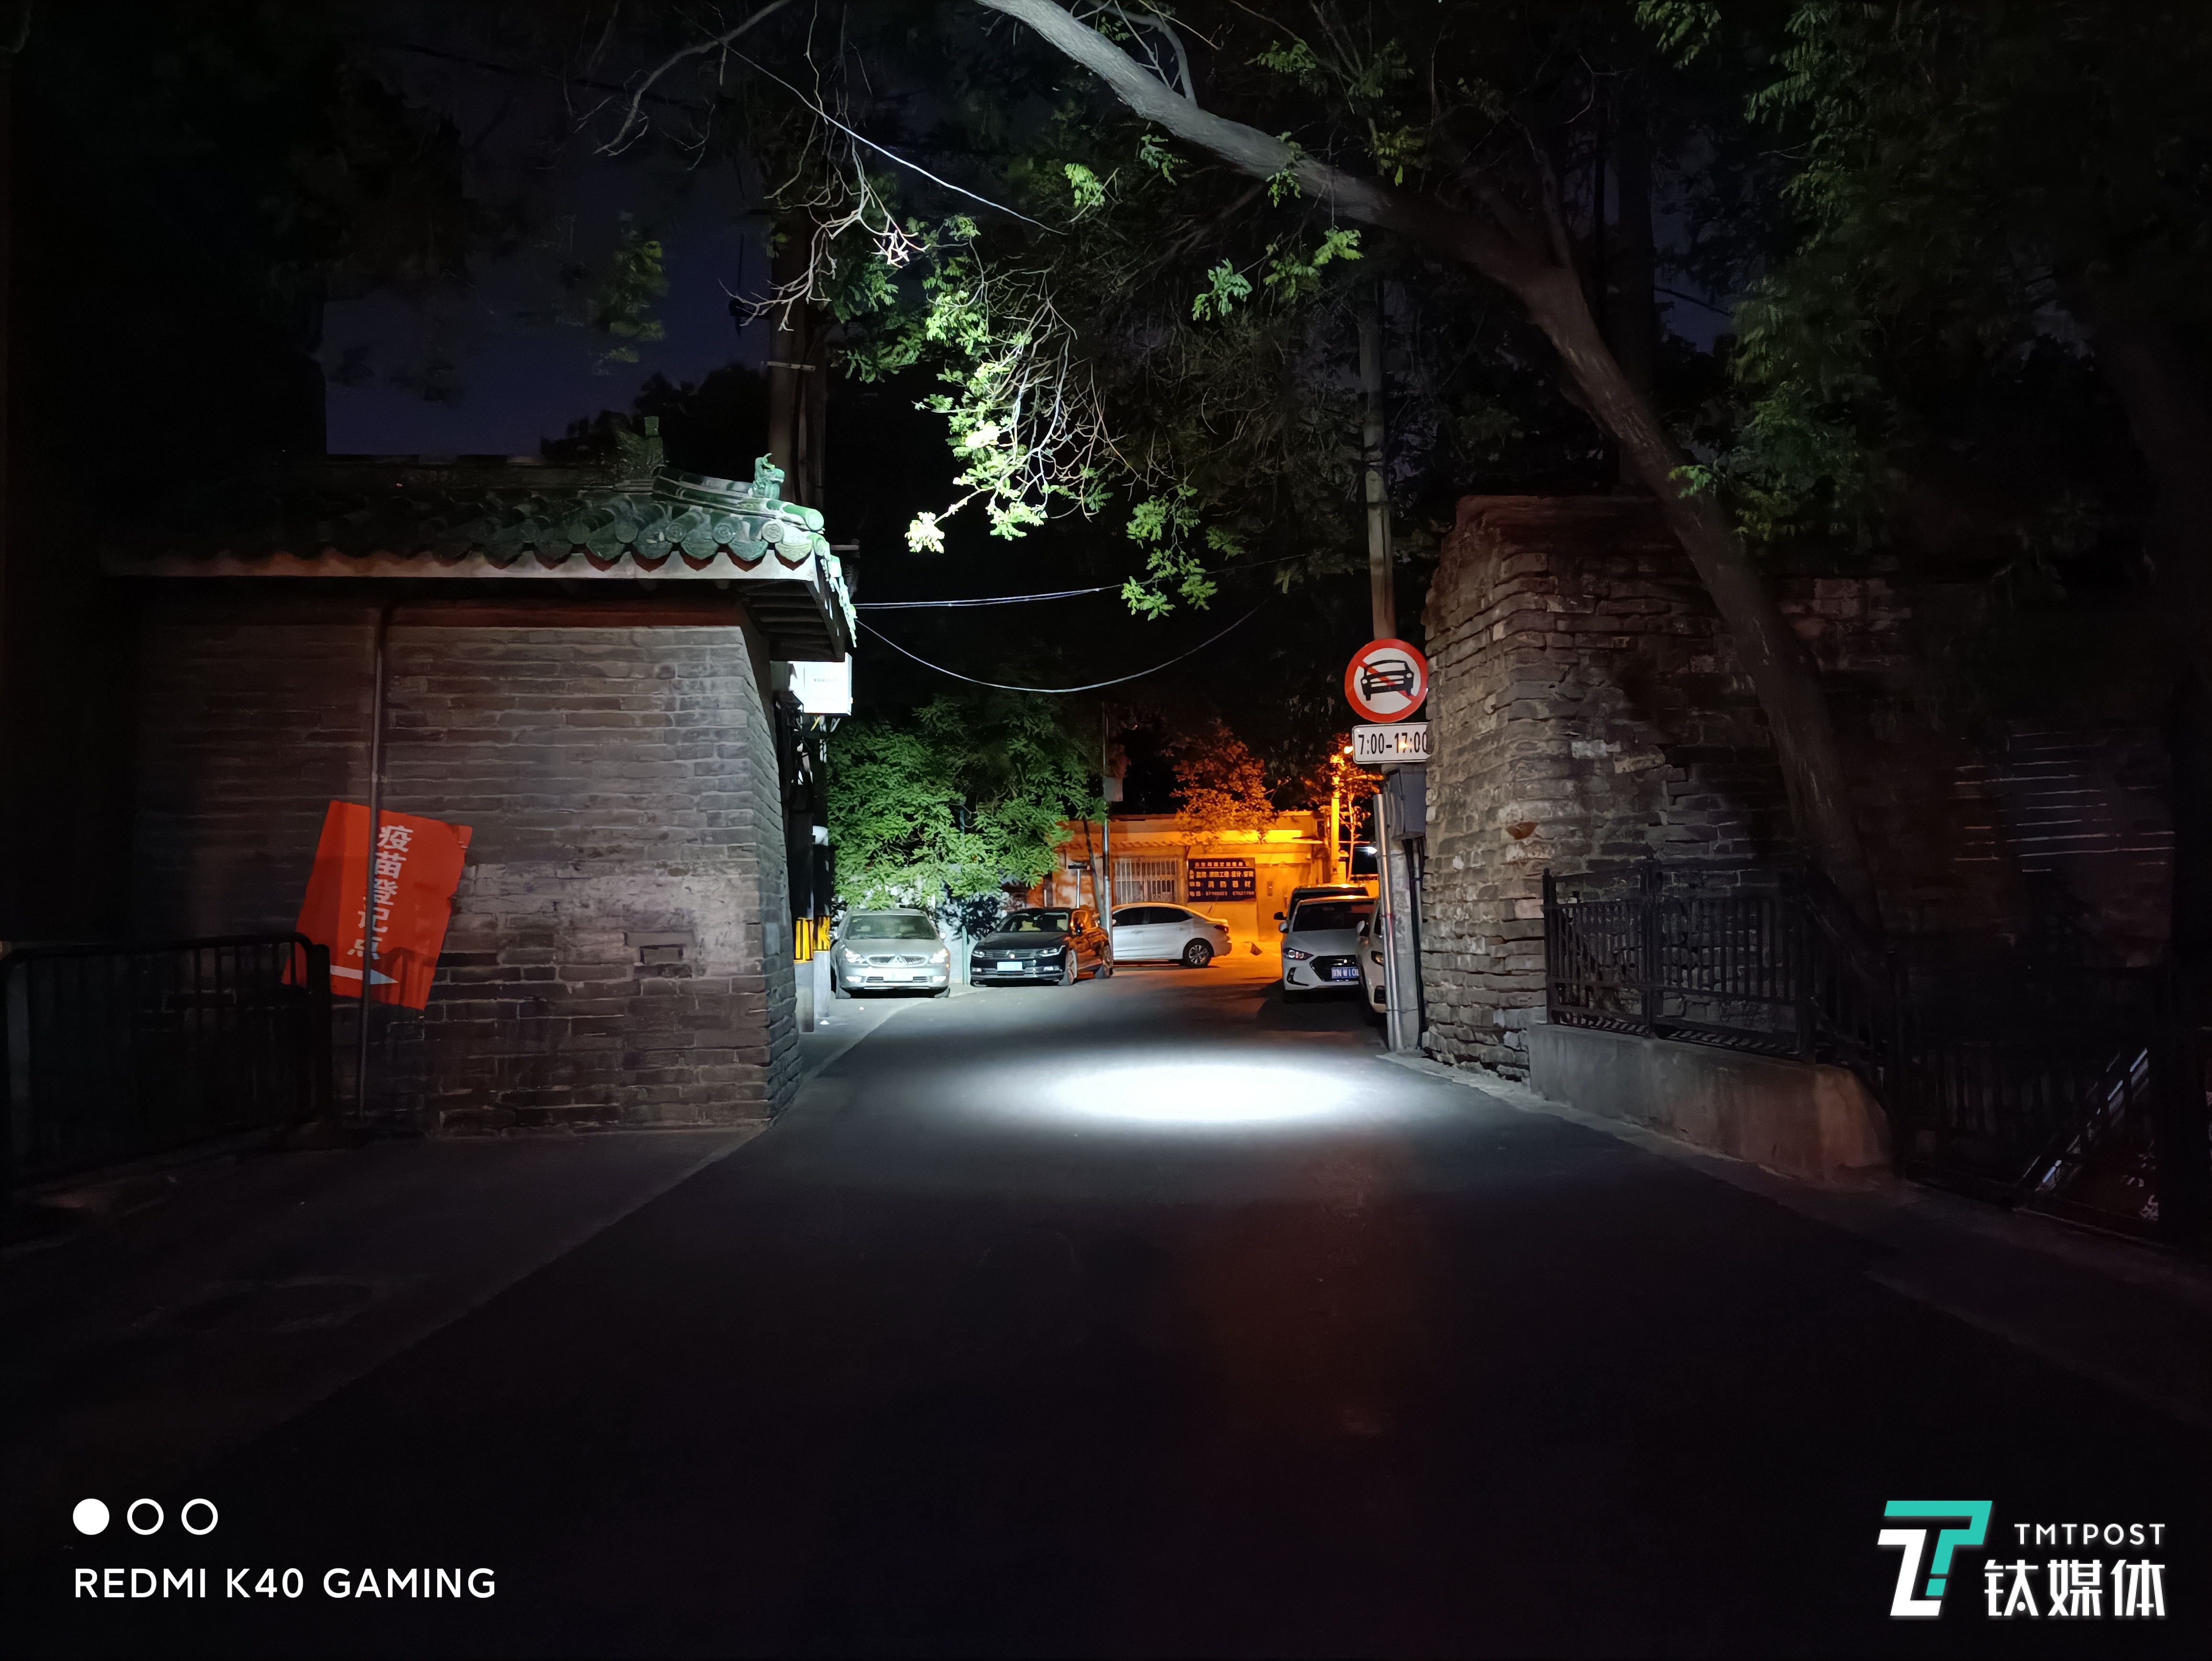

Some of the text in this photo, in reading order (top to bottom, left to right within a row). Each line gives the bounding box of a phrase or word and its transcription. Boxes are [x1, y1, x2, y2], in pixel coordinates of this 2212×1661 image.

[1358, 731, 1427, 755] 7:00-17:00
[347, 825, 413, 960] 疫苗登记点
